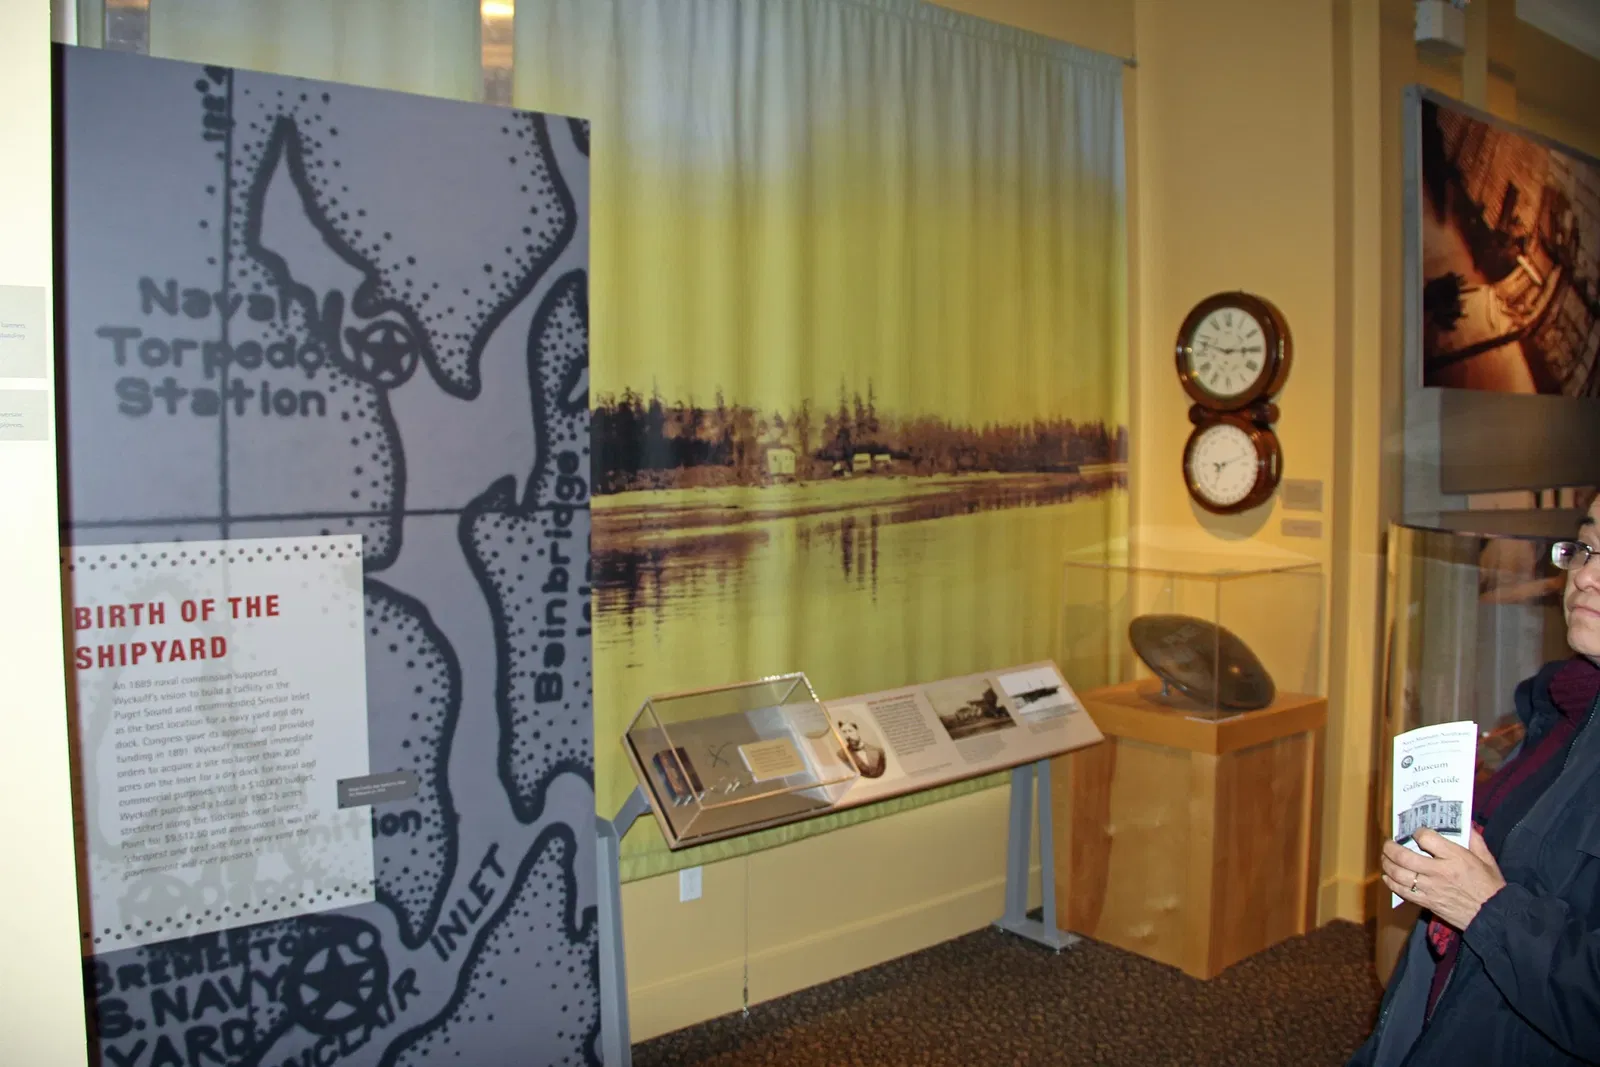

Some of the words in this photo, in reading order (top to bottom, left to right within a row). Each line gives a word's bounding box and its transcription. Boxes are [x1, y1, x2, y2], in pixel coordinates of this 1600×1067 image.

[138, 276, 291, 322] Naval
[95, 326, 328, 380] Torpedo
[115, 374, 327, 417] Station
[534, 450, 588, 703] Bainbridge
[74, 602, 166, 630] BIRTH
[181, 598, 216, 623] OF
[228, 594, 281, 619] THE
[75, 635, 228, 670] SHIPYARD
[235, 668, 277, 680] supported
[161, 691, 186, 700] vision
[202, 686, 223, 696] build
[277, 681, 290, 689] the
[114, 708, 141, 720] Puget
[144, 705, 172, 716] Sound
[176, 703, 192, 713] and
[258, 695, 288, 705] Sinclair
[128, 724, 141, 733] the
[146, 721, 164, 731] best
[167, 718, 203, 729] location
[206, 716, 220, 724] for
[230, 714, 248, 722] navy
[253, 710, 270, 721] yard
[273, 708, 288, 717] and
[292, 707, 304, 716] dry
[143, 735, 182, 746] Congress
[186, 732, 205, 743] gave
[261, 722, 276, 732] and
[279, 717, 314, 731] provided
[116, 752, 153, 763] funding
[271, 733, 313, 745] immediate
[117, 768, 145, 778] orders
[161, 762, 193, 773] acquire
[263, 750, 282, 759] than
[159, 778, 172, 787] the
[302, 759, 316, 769] and
[1413, 762, 1449, 773] Museum
[1402, 779, 1431, 793] Gallery
[1432, 775, 1460, 785] Guide
[119, 792, 171, 807] commercial
[120, 807, 157, 822] Wyckoff
[161, 801, 206, 817] purchased
[120, 821, 163, 835] stretched
[165, 819, 191, 829] along
[430, 842, 507, 963] INLET
[151, 962, 290, 1027] NAVY
[104, 1018, 256, 1067] YARD
